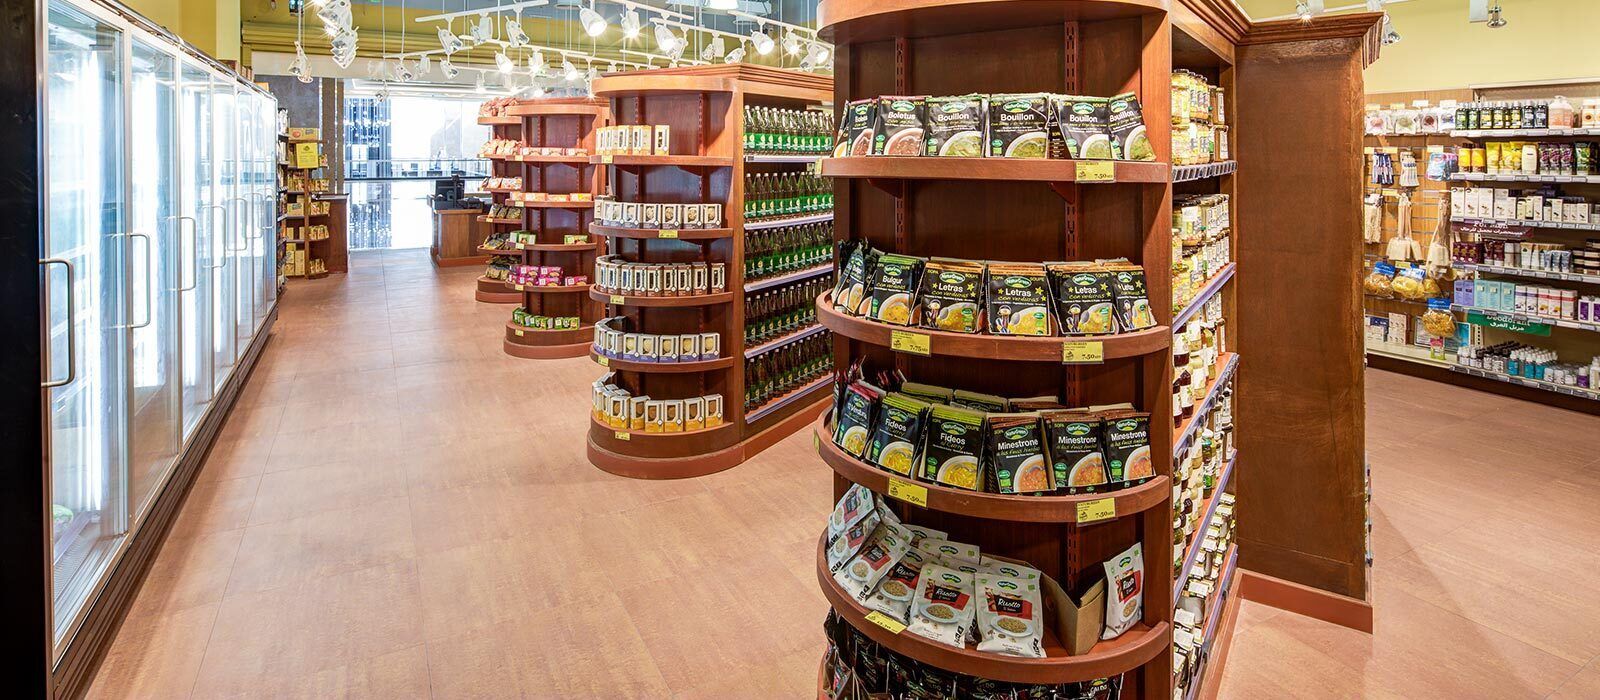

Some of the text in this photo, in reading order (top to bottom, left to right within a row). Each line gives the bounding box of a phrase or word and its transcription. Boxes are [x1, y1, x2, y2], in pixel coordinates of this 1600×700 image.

[938, 112, 970, 122] Bouillon
[1000, 113, 1034, 121] Bouillon
[1069, 114, 1098, 122] Bouillon
[1109, 110, 1135, 122] Bouillon
[882, 275, 903, 285] Bulgur
[938, 282, 963, 293] Letras
[1005, 288, 1032, 297] Letras
[1074, 286, 1098, 294] Letras
[885, 418, 907, 432] Fideos
[940, 432, 966, 446] Fideos
[1110, 430, 1146, 442] Minestrone
[998, 438, 1039, 452] Minestrone
[936, 588, 958, 598] Risotto
[998, 598, 1022, 608] Risotto
